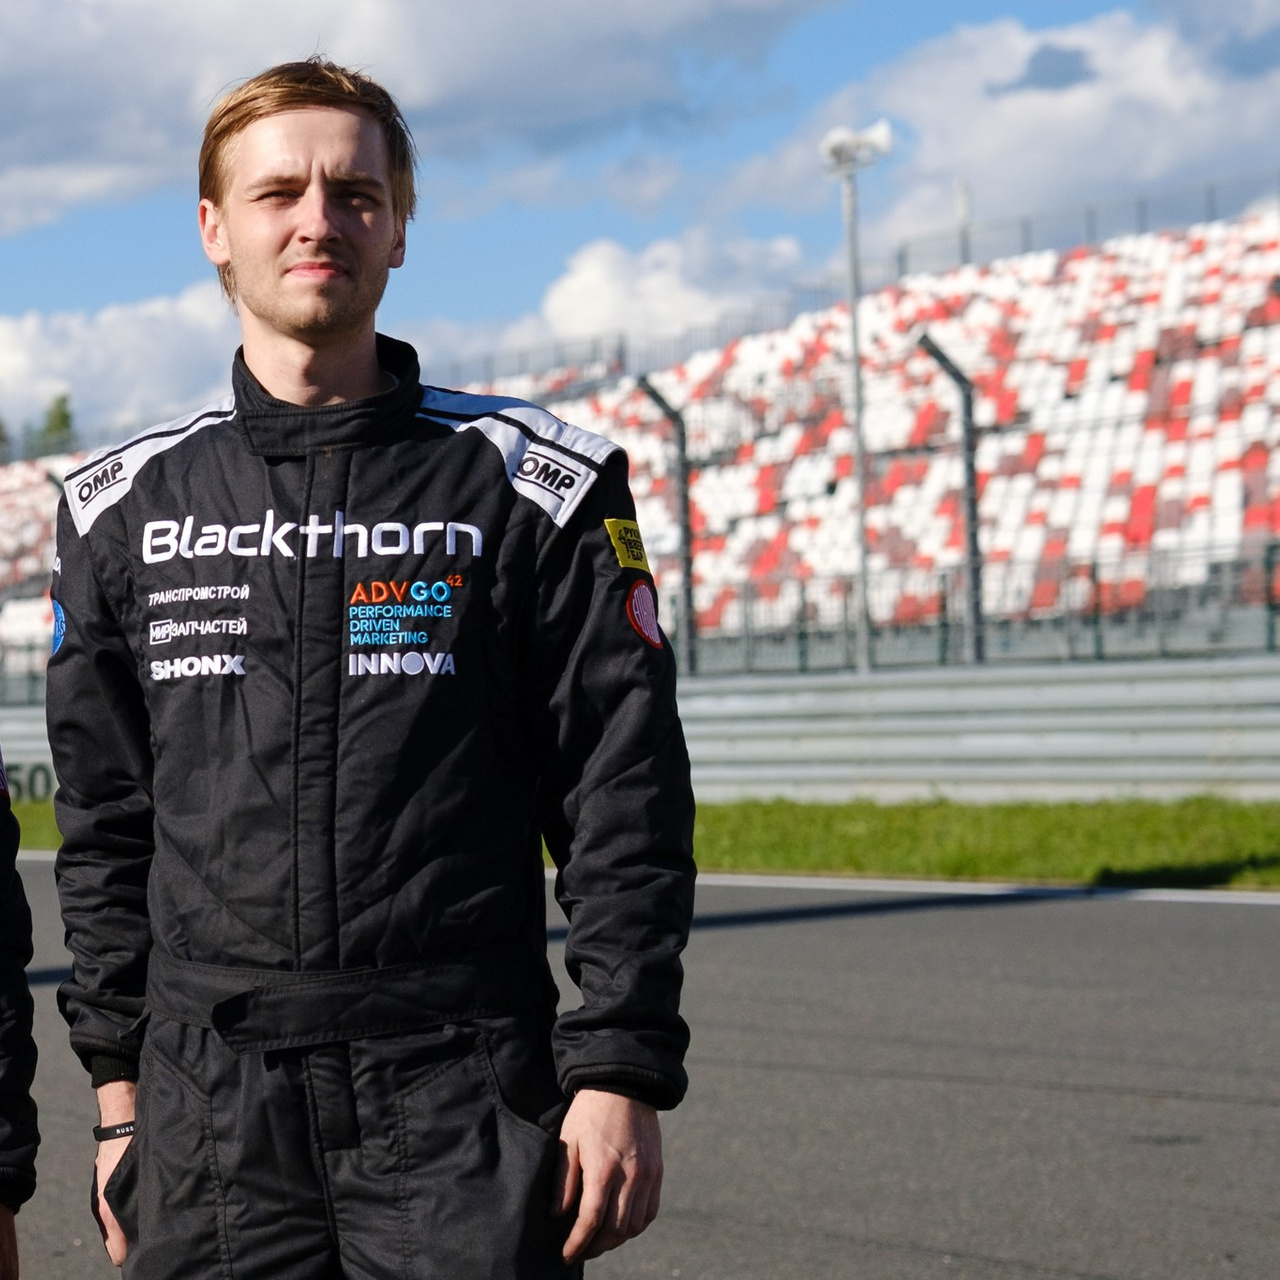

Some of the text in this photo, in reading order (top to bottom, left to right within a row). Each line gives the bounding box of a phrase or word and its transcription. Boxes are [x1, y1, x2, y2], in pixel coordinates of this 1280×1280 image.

[78, 461, 123, 502] OMP
[518, 457, 575, 491] OMP
[142, 509, 482, 564] Blackthorn
[148, 584, 250, 606] ТРАНСПРОМСТРОЙ
[349, 604, 452, 619] PERFORMANCE
[350, 619, 400, 634] DRIVEN
[350, 631, 428, 646] MARKETING
[150, 654, 246, 680] SHONX
[348, 651, 456, 675] INNOVA
